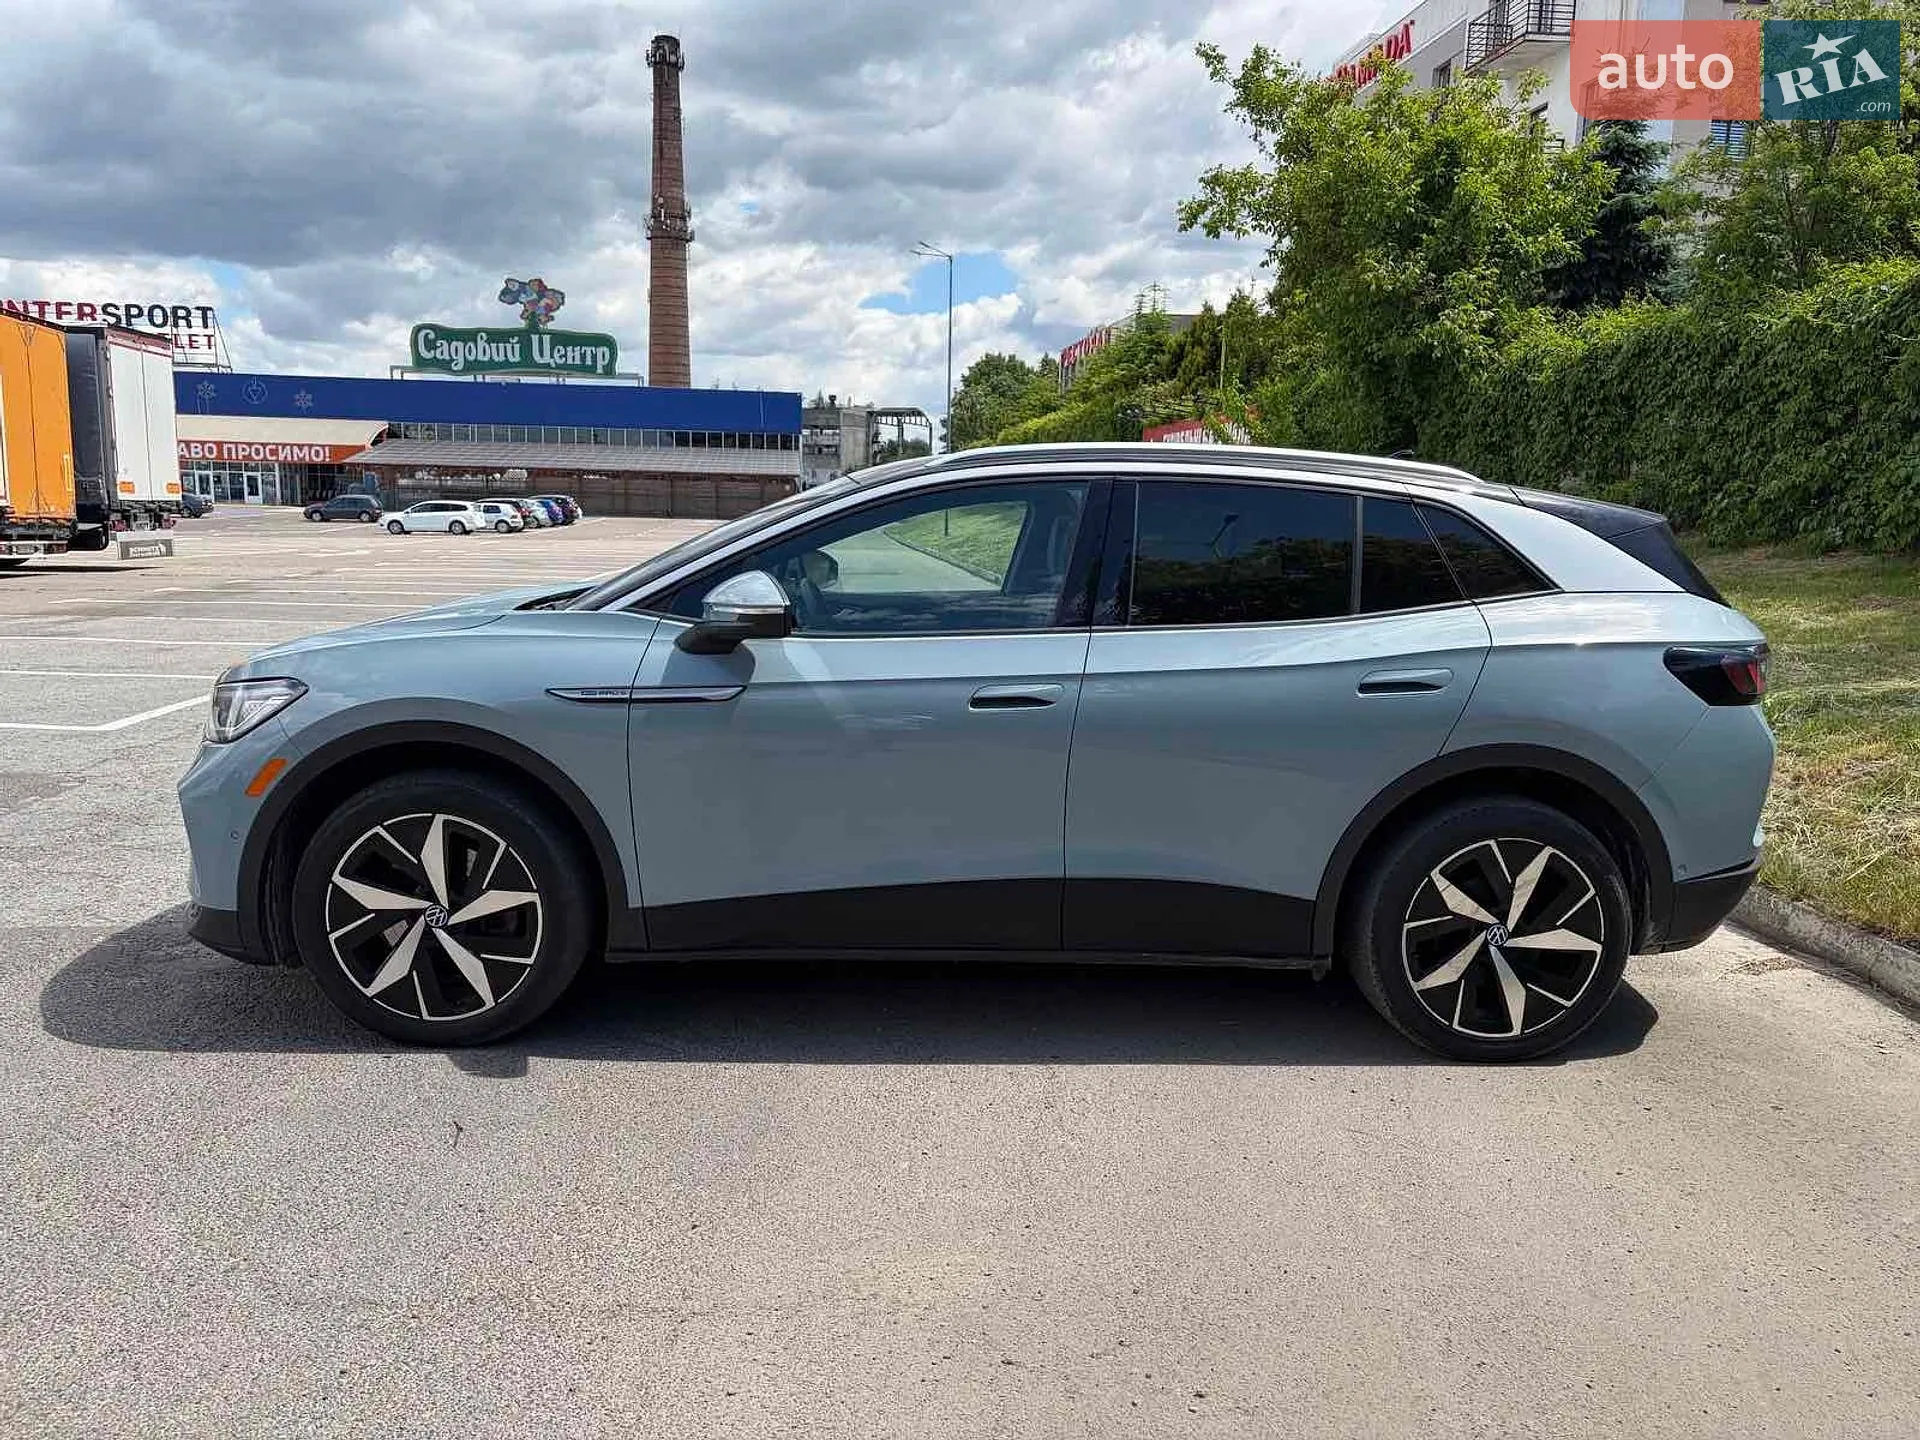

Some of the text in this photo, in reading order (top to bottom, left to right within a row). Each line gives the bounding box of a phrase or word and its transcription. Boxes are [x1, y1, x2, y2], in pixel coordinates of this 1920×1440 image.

[174, 334, 214, 349] LET
[417, 329, 610, 374] Садовий Центр
[178, 442, 330, 462] АВО ПРОСИМО!
